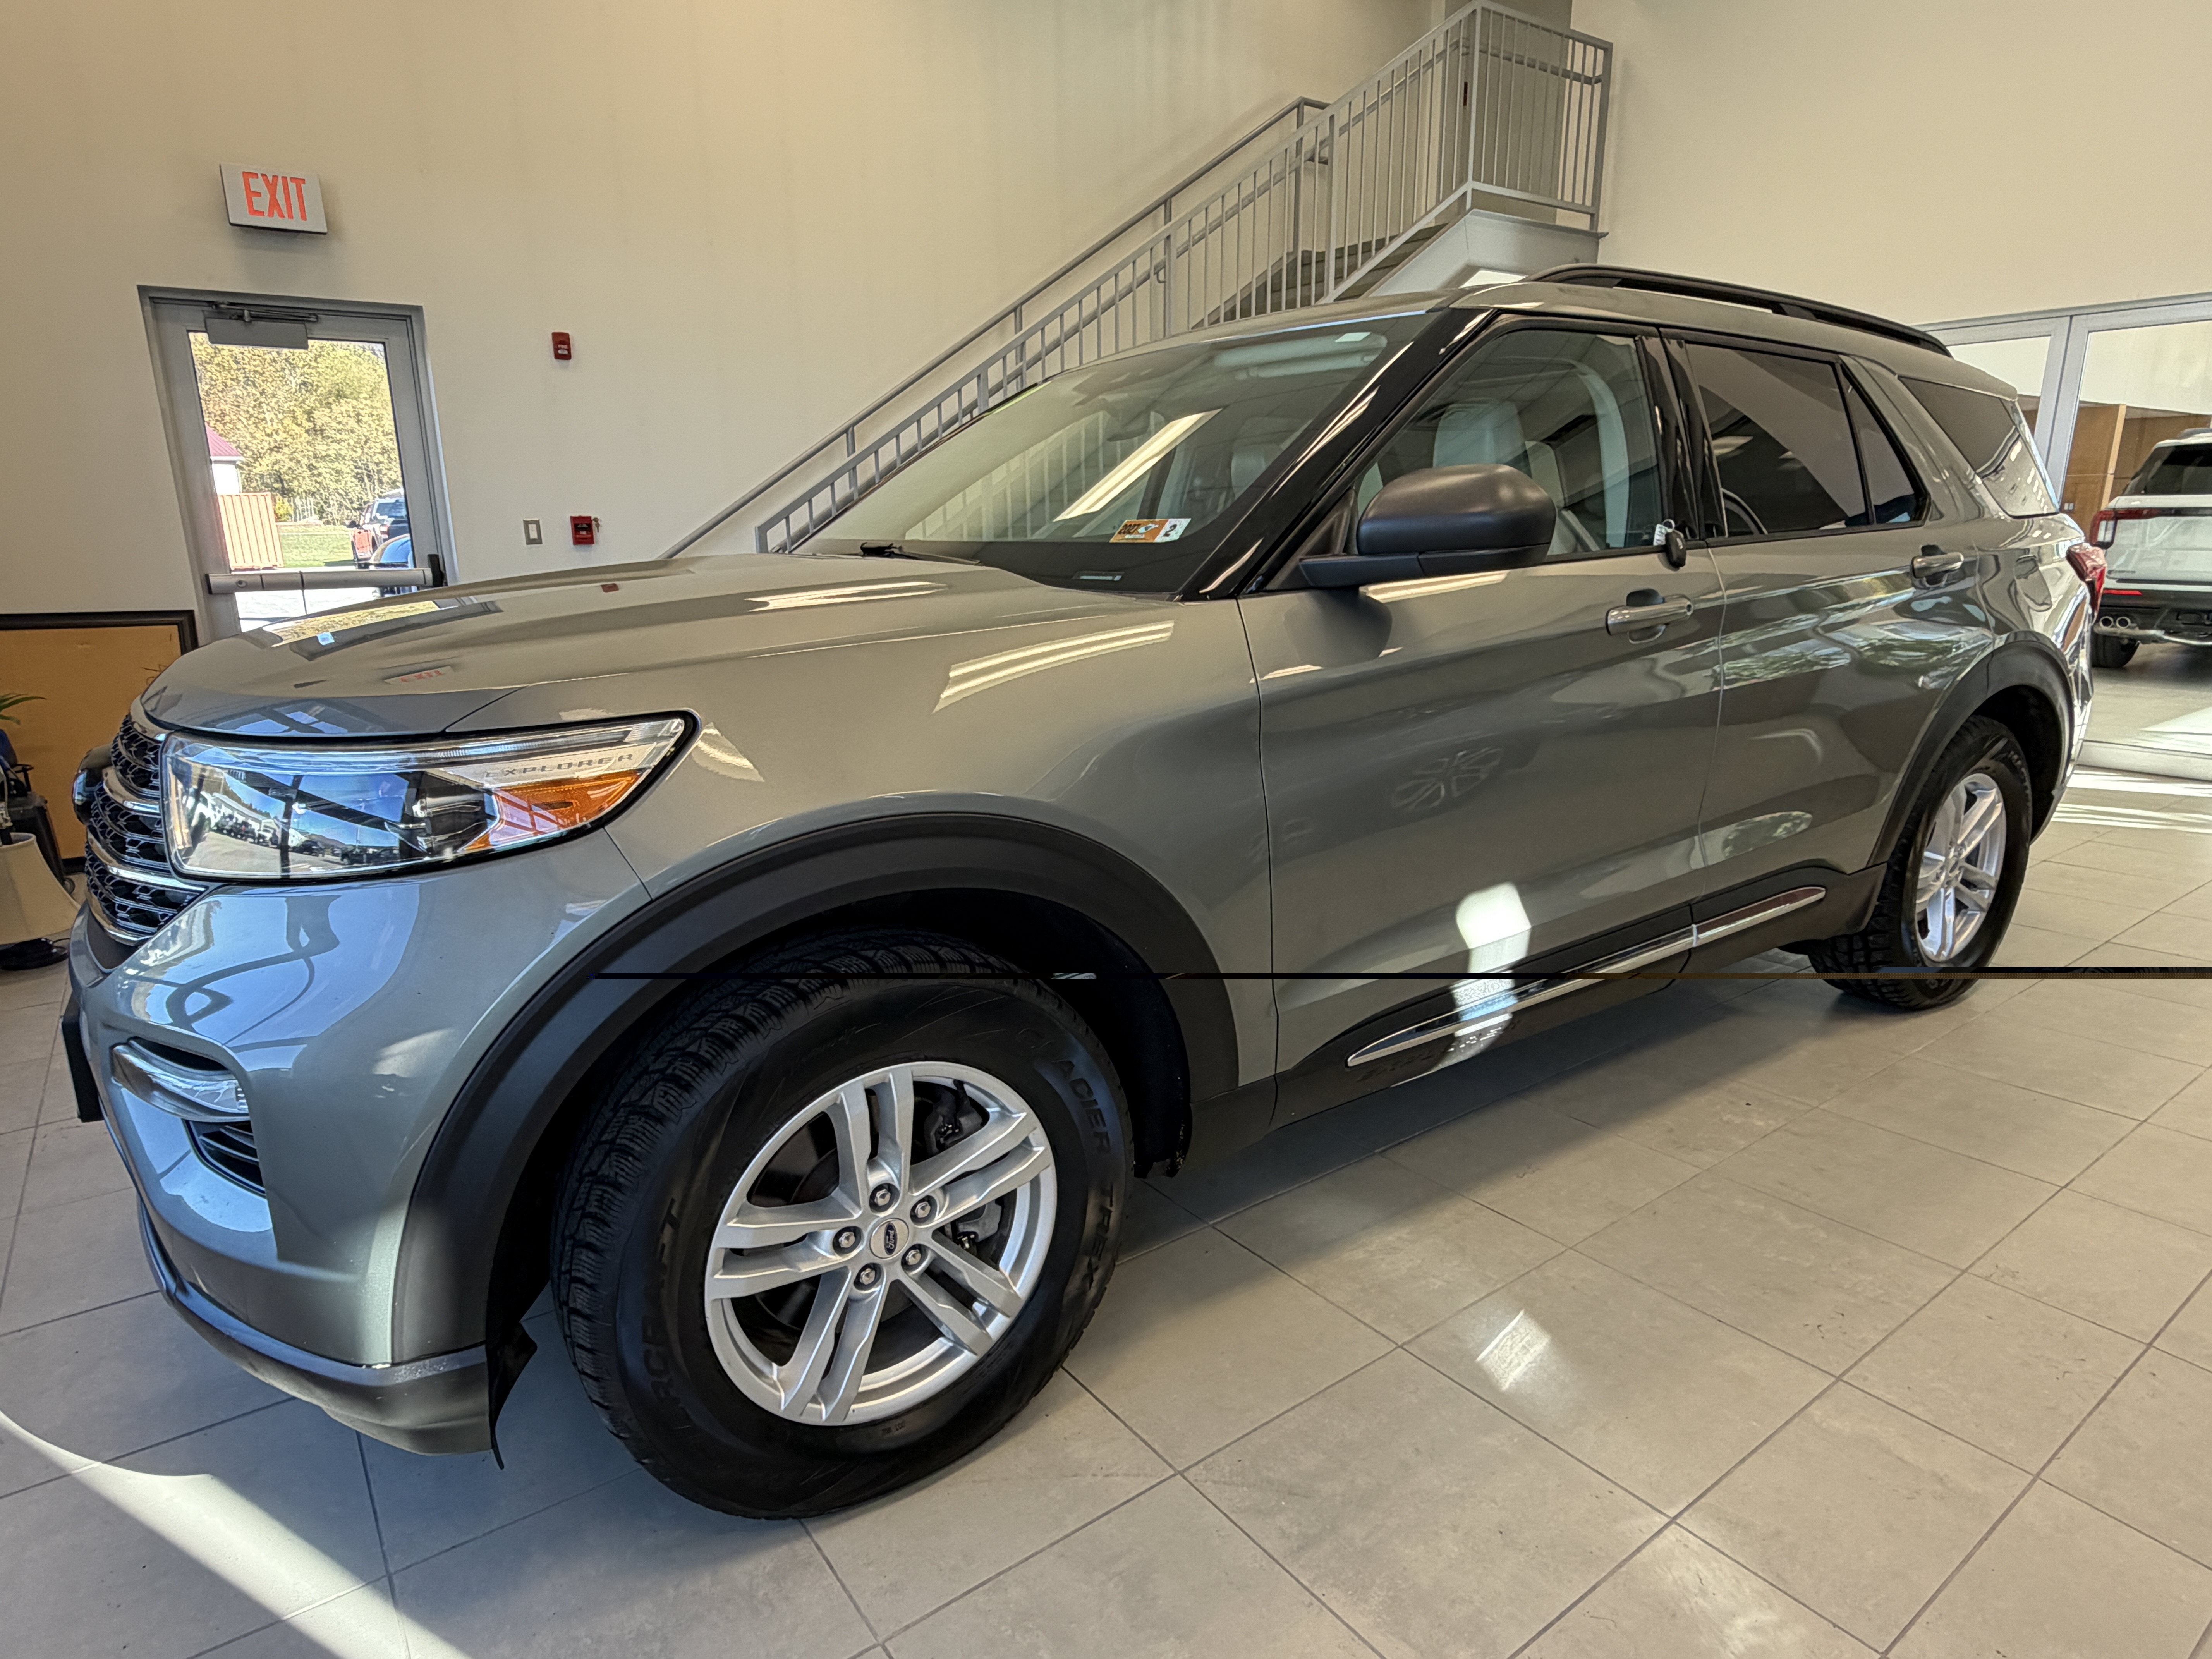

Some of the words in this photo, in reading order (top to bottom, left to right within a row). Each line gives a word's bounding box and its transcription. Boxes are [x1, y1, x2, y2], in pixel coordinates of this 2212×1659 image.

[242, 171, 307, 222] EXIT
[1163, 524, 1177, 537] 2
[485, 753, 633, 778] EXPLORER
